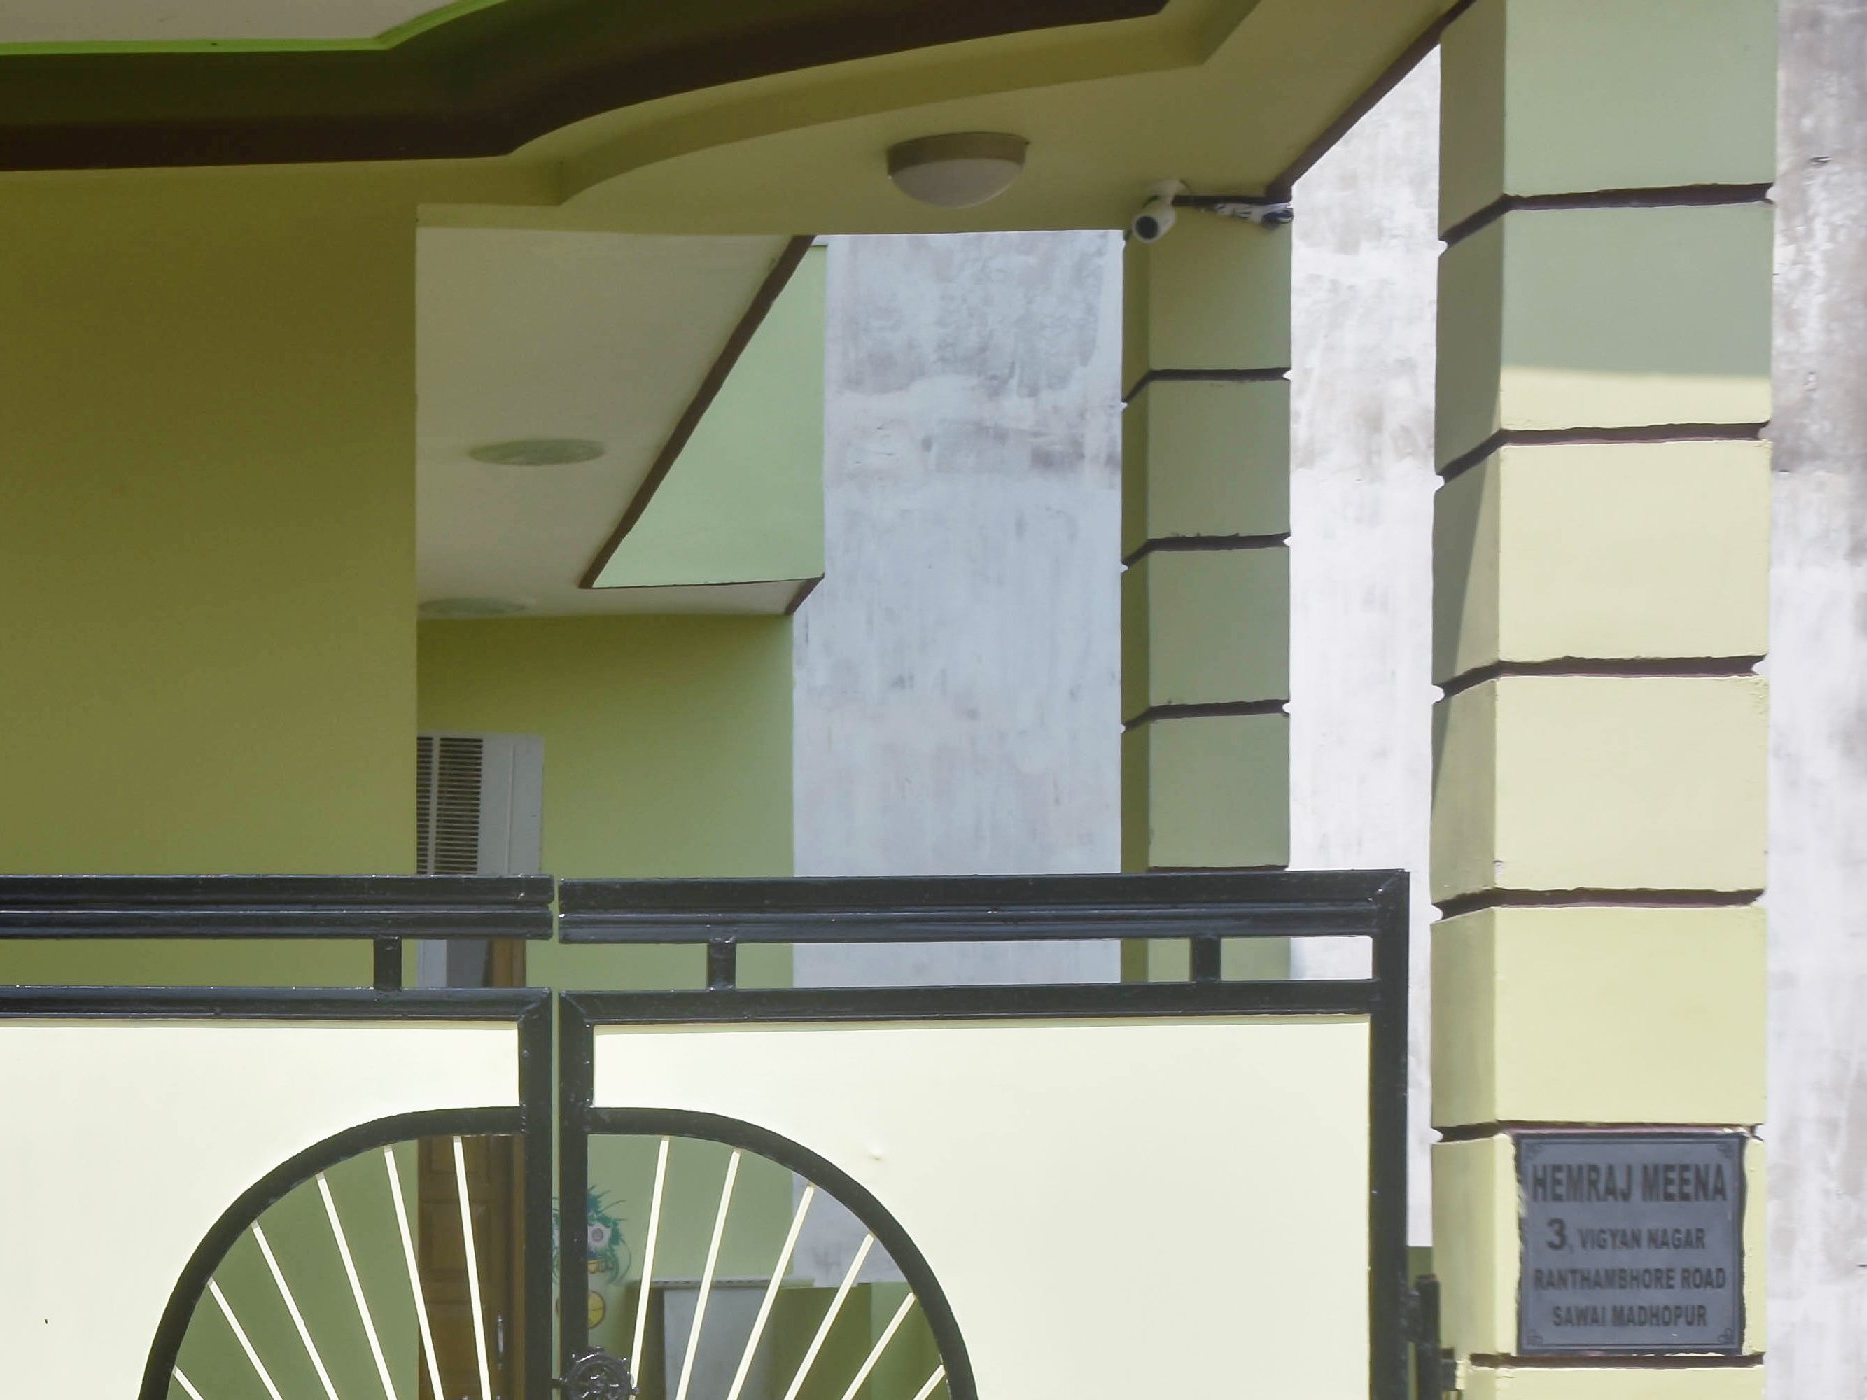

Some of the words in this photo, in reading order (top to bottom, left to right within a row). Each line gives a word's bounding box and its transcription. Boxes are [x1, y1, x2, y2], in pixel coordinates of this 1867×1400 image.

[1532, 1164, 1632, 1202] HEMRAJ
[1641, 1164, 1727, 1202] MEENA
[1577, 1227, 1642, 1250] VIGYAN
[1647, 1227, 1706, 1250] NAGAR
[1533, 1267, 1675, 1290] RANTHAMBHORE
[1681, 1267, 1726, 1290] ROAD
[1552, 1304, 1608, 1328] SAWAI
[1612, 1304, 1708, 1327] MADHOPUR
